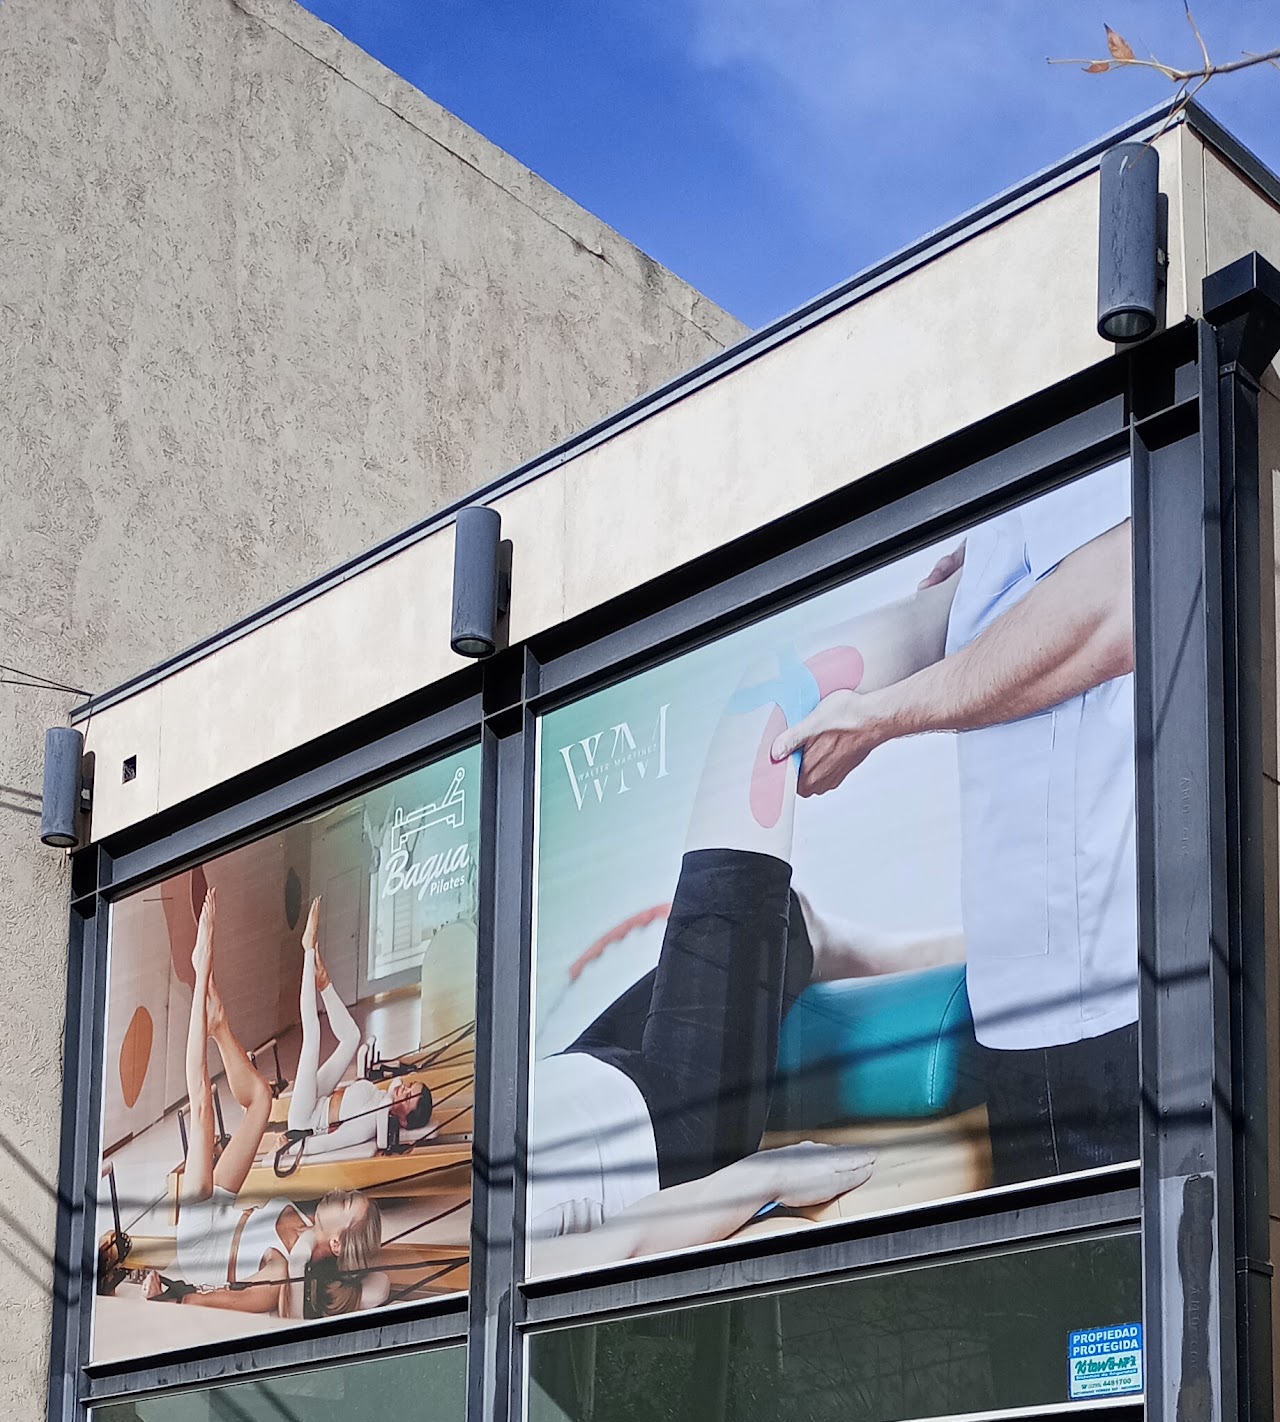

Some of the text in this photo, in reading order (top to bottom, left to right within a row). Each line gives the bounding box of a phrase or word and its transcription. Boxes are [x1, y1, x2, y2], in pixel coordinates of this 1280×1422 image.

[381, 843, 470, 901] Bagua
[429, 874, 466, 897] Pilates
[1073, 1326, 1138, 1345] PROPIEDAD
[1073, 1339, 1139, 1357] PROTEGIDA
